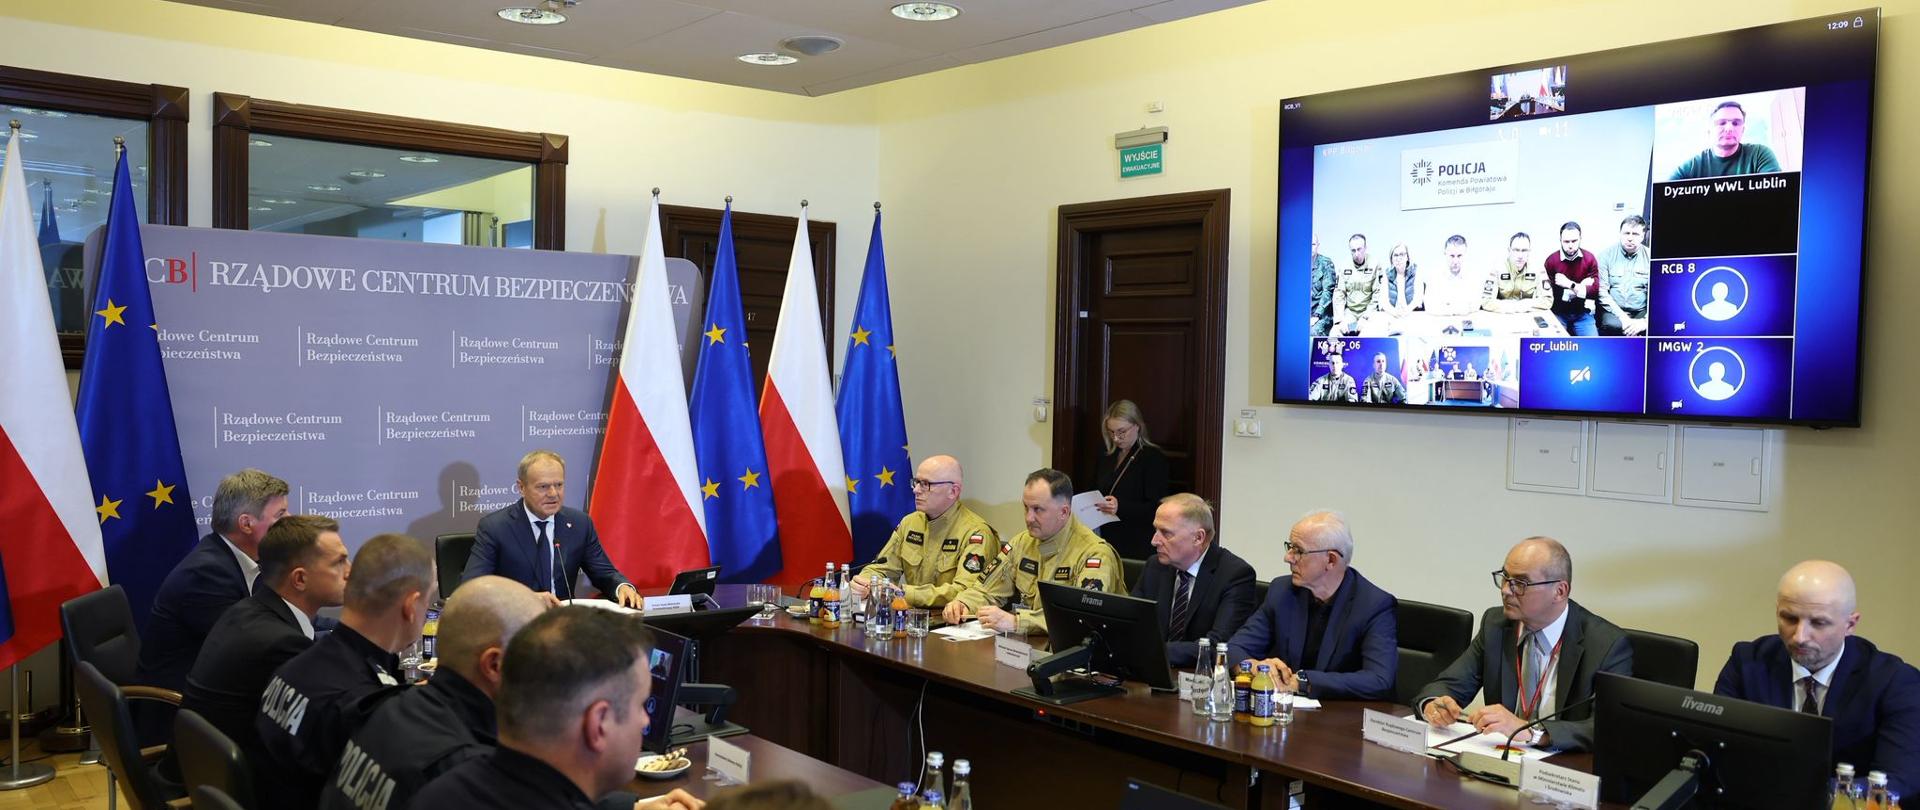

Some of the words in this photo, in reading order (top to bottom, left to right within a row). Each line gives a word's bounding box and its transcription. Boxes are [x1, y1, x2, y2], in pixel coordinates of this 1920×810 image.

[1827, 20, 1849, 30] 12:09
[1124, 150, 1158, 163] WYJŚCIE
[1438, 162, 1486, 176] POLICJA
[1437, 178, 1469, 187] Komenda
[1470, 175, 1507, 185] Powiatowa
[1664, 183, 1710, 197] Dyzurny
[1714, 180, 1744, 193] WWL
[1749, 177, 1787, 191] Lublin
[145, 257, 188, 284] CB
[1661, 263, 1684, 274] RCB
[1687, 262, 1696, 274] 8
[209, 261, 356, 293] RZĄDOWE
[361, 269, 491, 299] CENTRUM
[158, 329, 194, 342] dowe
[199, 330, 259, 343] Centrum
[306, 333, 363, 348] Rządowe
[365, 334, 419, 347] Centrum
[460, 336, 509, 350] Rządowe
[511, 336, 559, 350] Centrum
[595, 339, 624, 352] Rząd
[1529, 341, 1579, 352] cpr_lublin
[1658, 341, 1692, 352] IMGW
[1696, 341, 1704, 352] 2
[306, 349, 403, 364] Bezpieczeństwa
[460, 352, 544, 367] Bezpieczeństwa
[223, 413, 282, 426] Rządowe
[286, 412, 342, 425] Centrum
[386, 411, 439, 425] Rządowe
[441, 411, 490, 423] Centrum
[529, 410, 575, 423] Rządowe
[577, 409, 608, 421] Centr
[223, 428, 325, 443] Bezpieczeństwa
[386, 427, 475, 442] Bezpieczeństwa
[308, 490, 364, 505] Rządowe
[366, 488, 419, 502] Centrum
[460, 485, 509, 498] Rządowe
